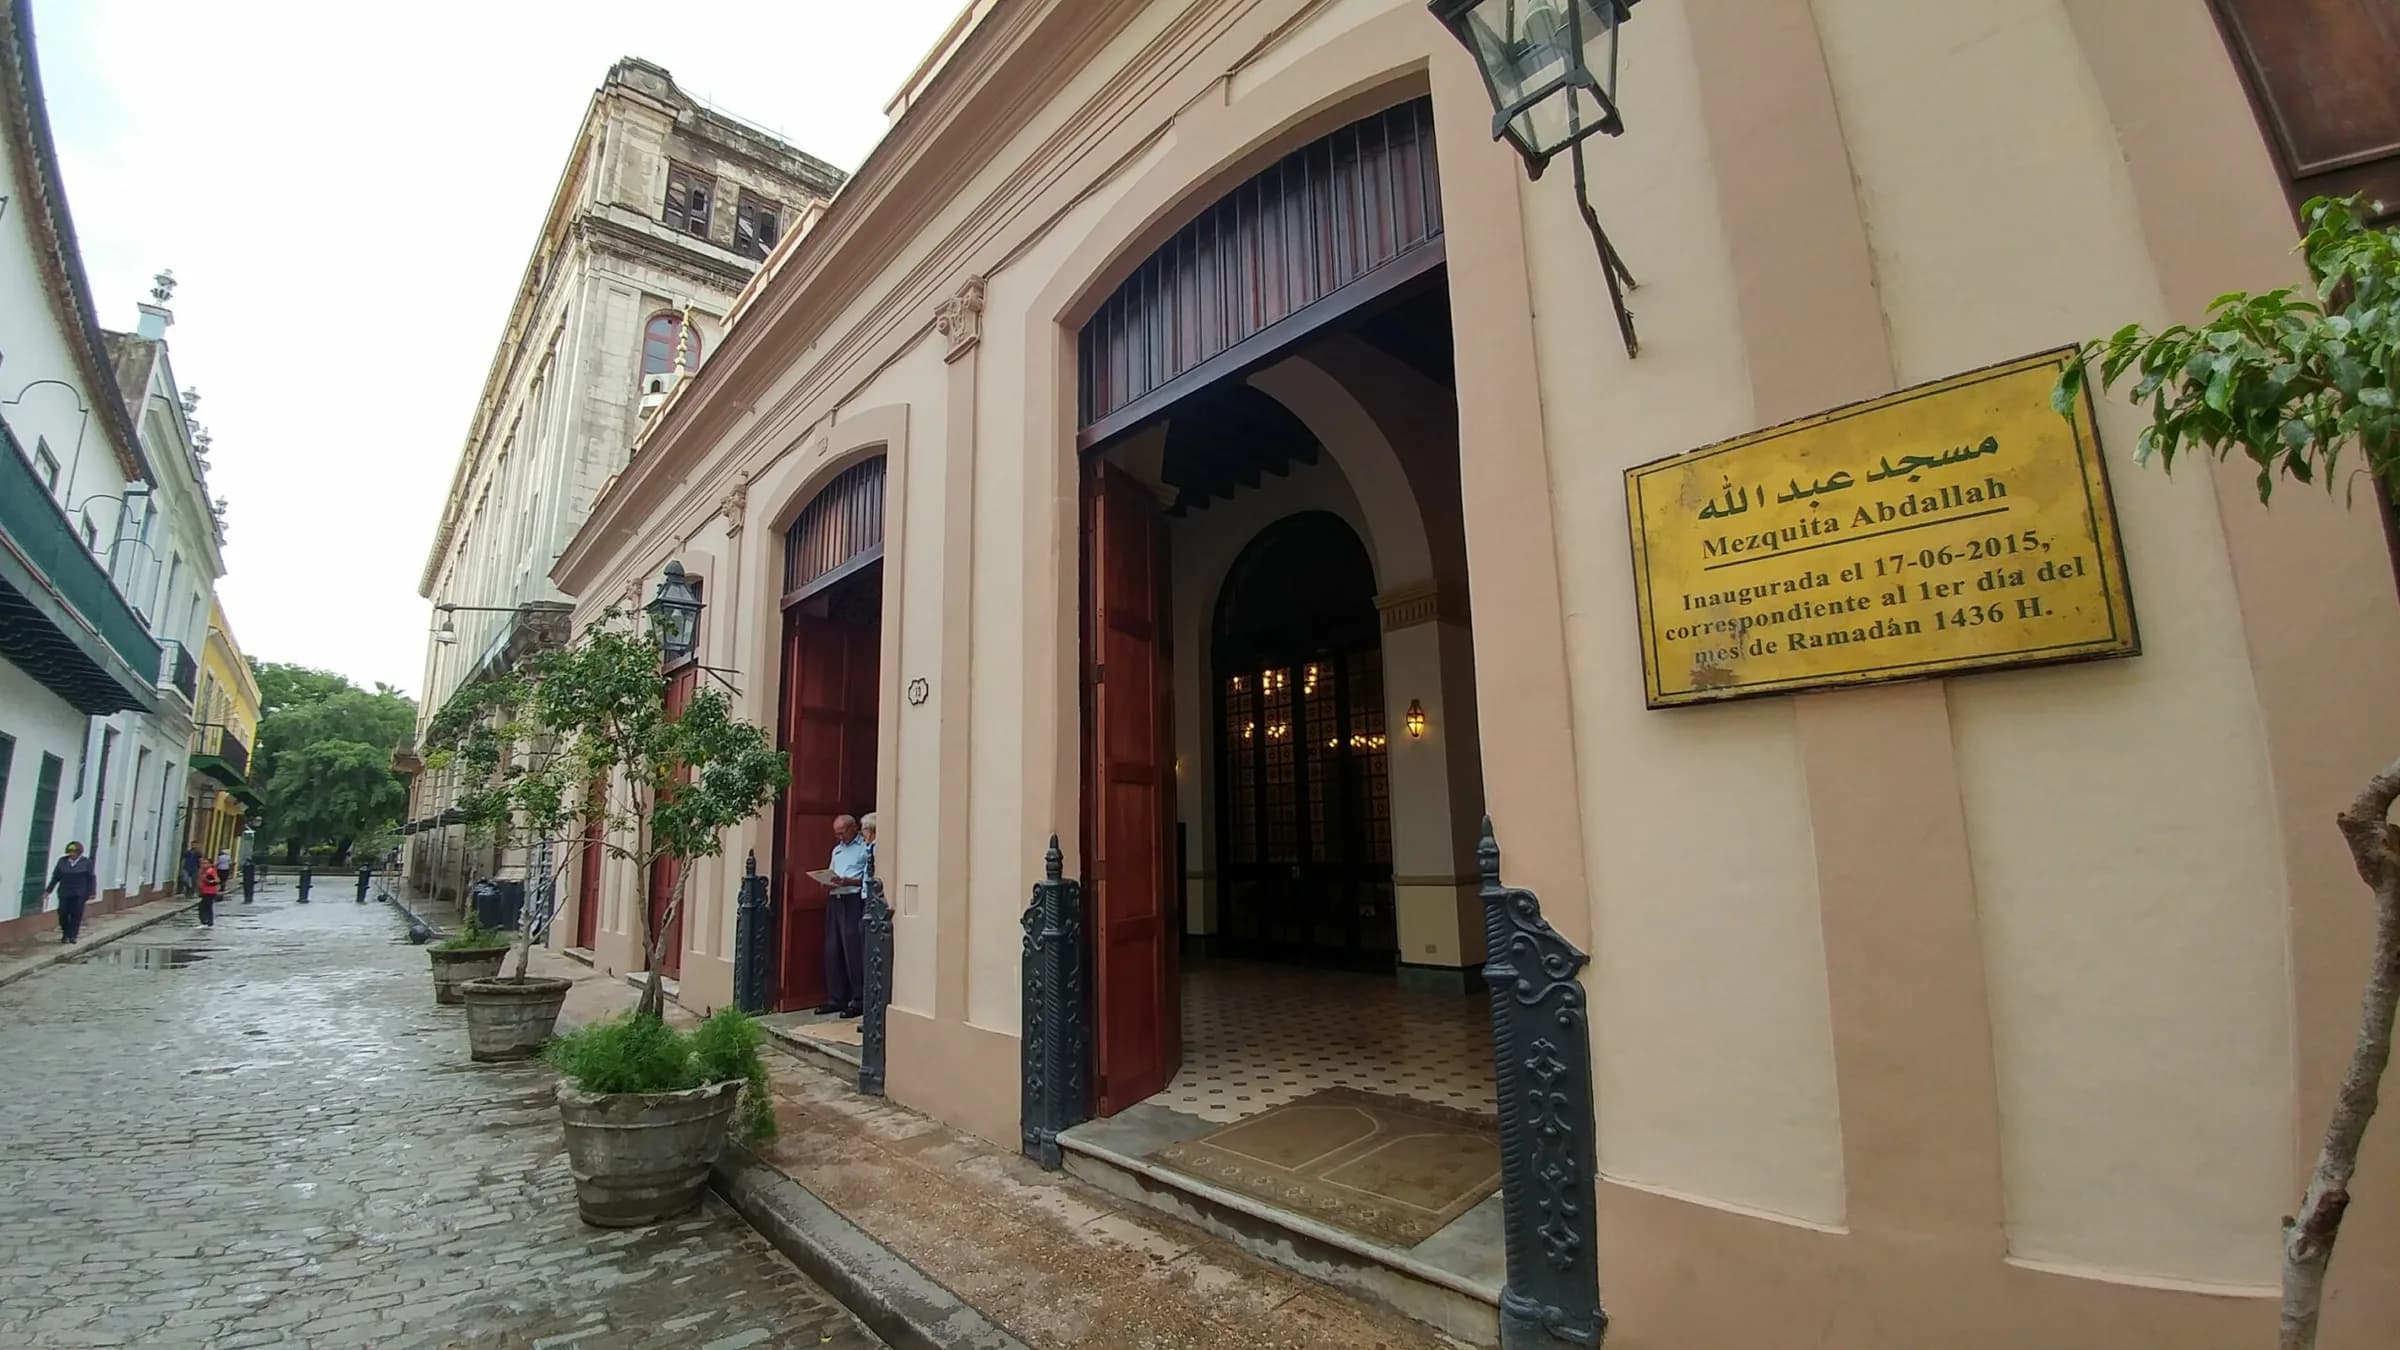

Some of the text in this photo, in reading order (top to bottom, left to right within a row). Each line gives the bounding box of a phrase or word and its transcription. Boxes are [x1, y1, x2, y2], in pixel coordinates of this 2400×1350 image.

[1777, 471, 1855, 509] عبد
[1866, 436, 1999, 483] مسجد
[1703, 478, 2007, 559] Mezquita Abdallah
[1666, 595, 1871, 641] correspondiente
[1882, 584, 1907, 607] al
[1977, 567, 2025, 592] día
[2037, 556, 2086, 583] del
[1683, 530, 2051, 611] Inaugurada el 17-06-2015,
[1695, 597, 2053, 665] mes de Ramadán 1436 H.
